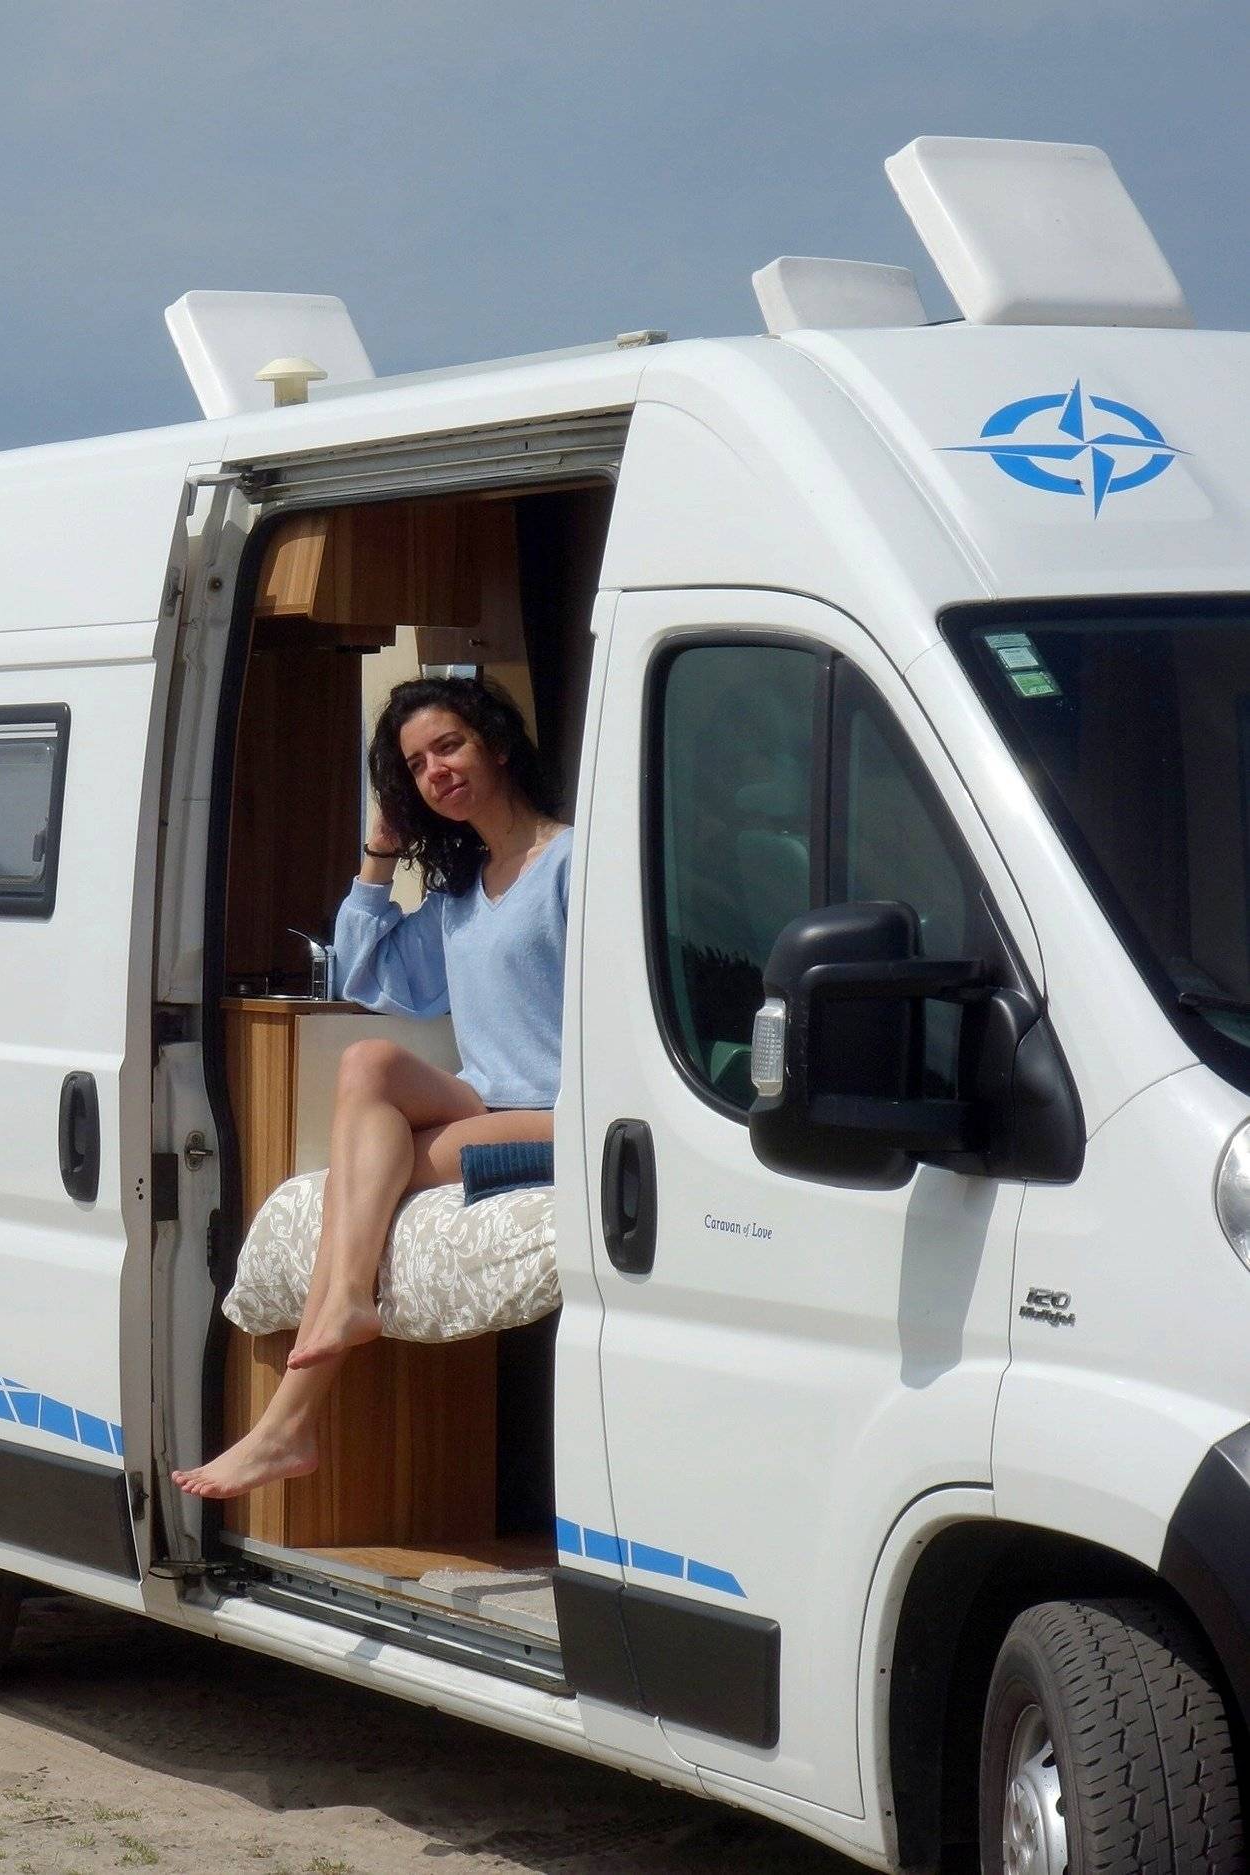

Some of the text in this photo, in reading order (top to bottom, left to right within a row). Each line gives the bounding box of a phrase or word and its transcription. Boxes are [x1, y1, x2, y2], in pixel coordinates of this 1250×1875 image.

[704, 1214, 773, 1240] Caravan of Love
